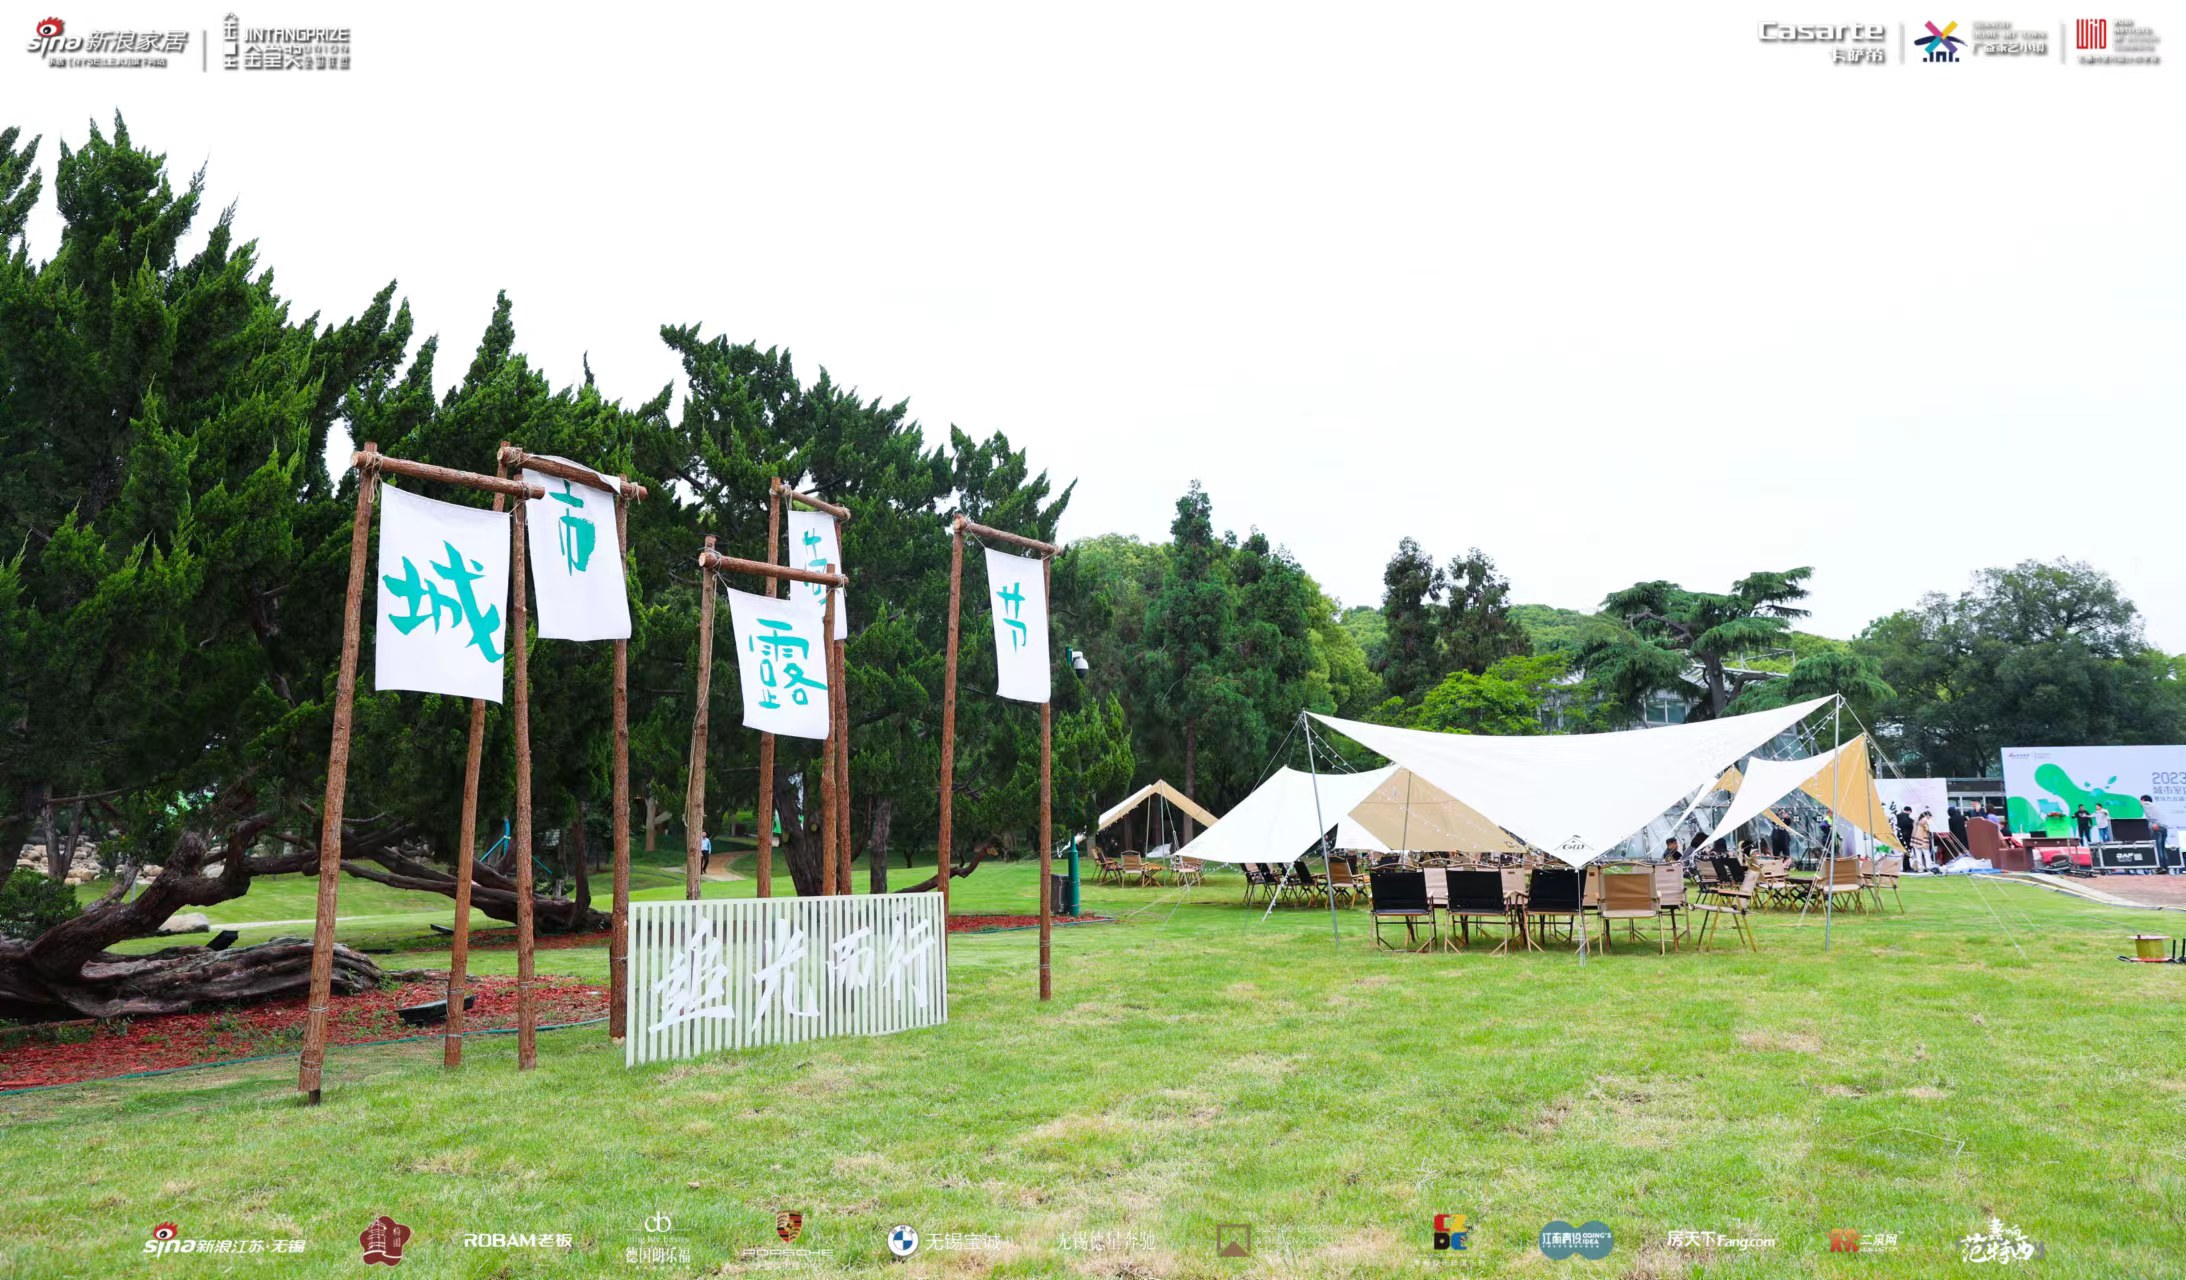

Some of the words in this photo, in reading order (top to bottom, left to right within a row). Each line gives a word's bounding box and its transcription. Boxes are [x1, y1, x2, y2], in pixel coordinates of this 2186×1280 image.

[548, 479, 596, 577] 市
[382, 539, 504, 664] 城
[749, 617, 829, 710] 露
[2152, 771, 2186, 785] 2023
